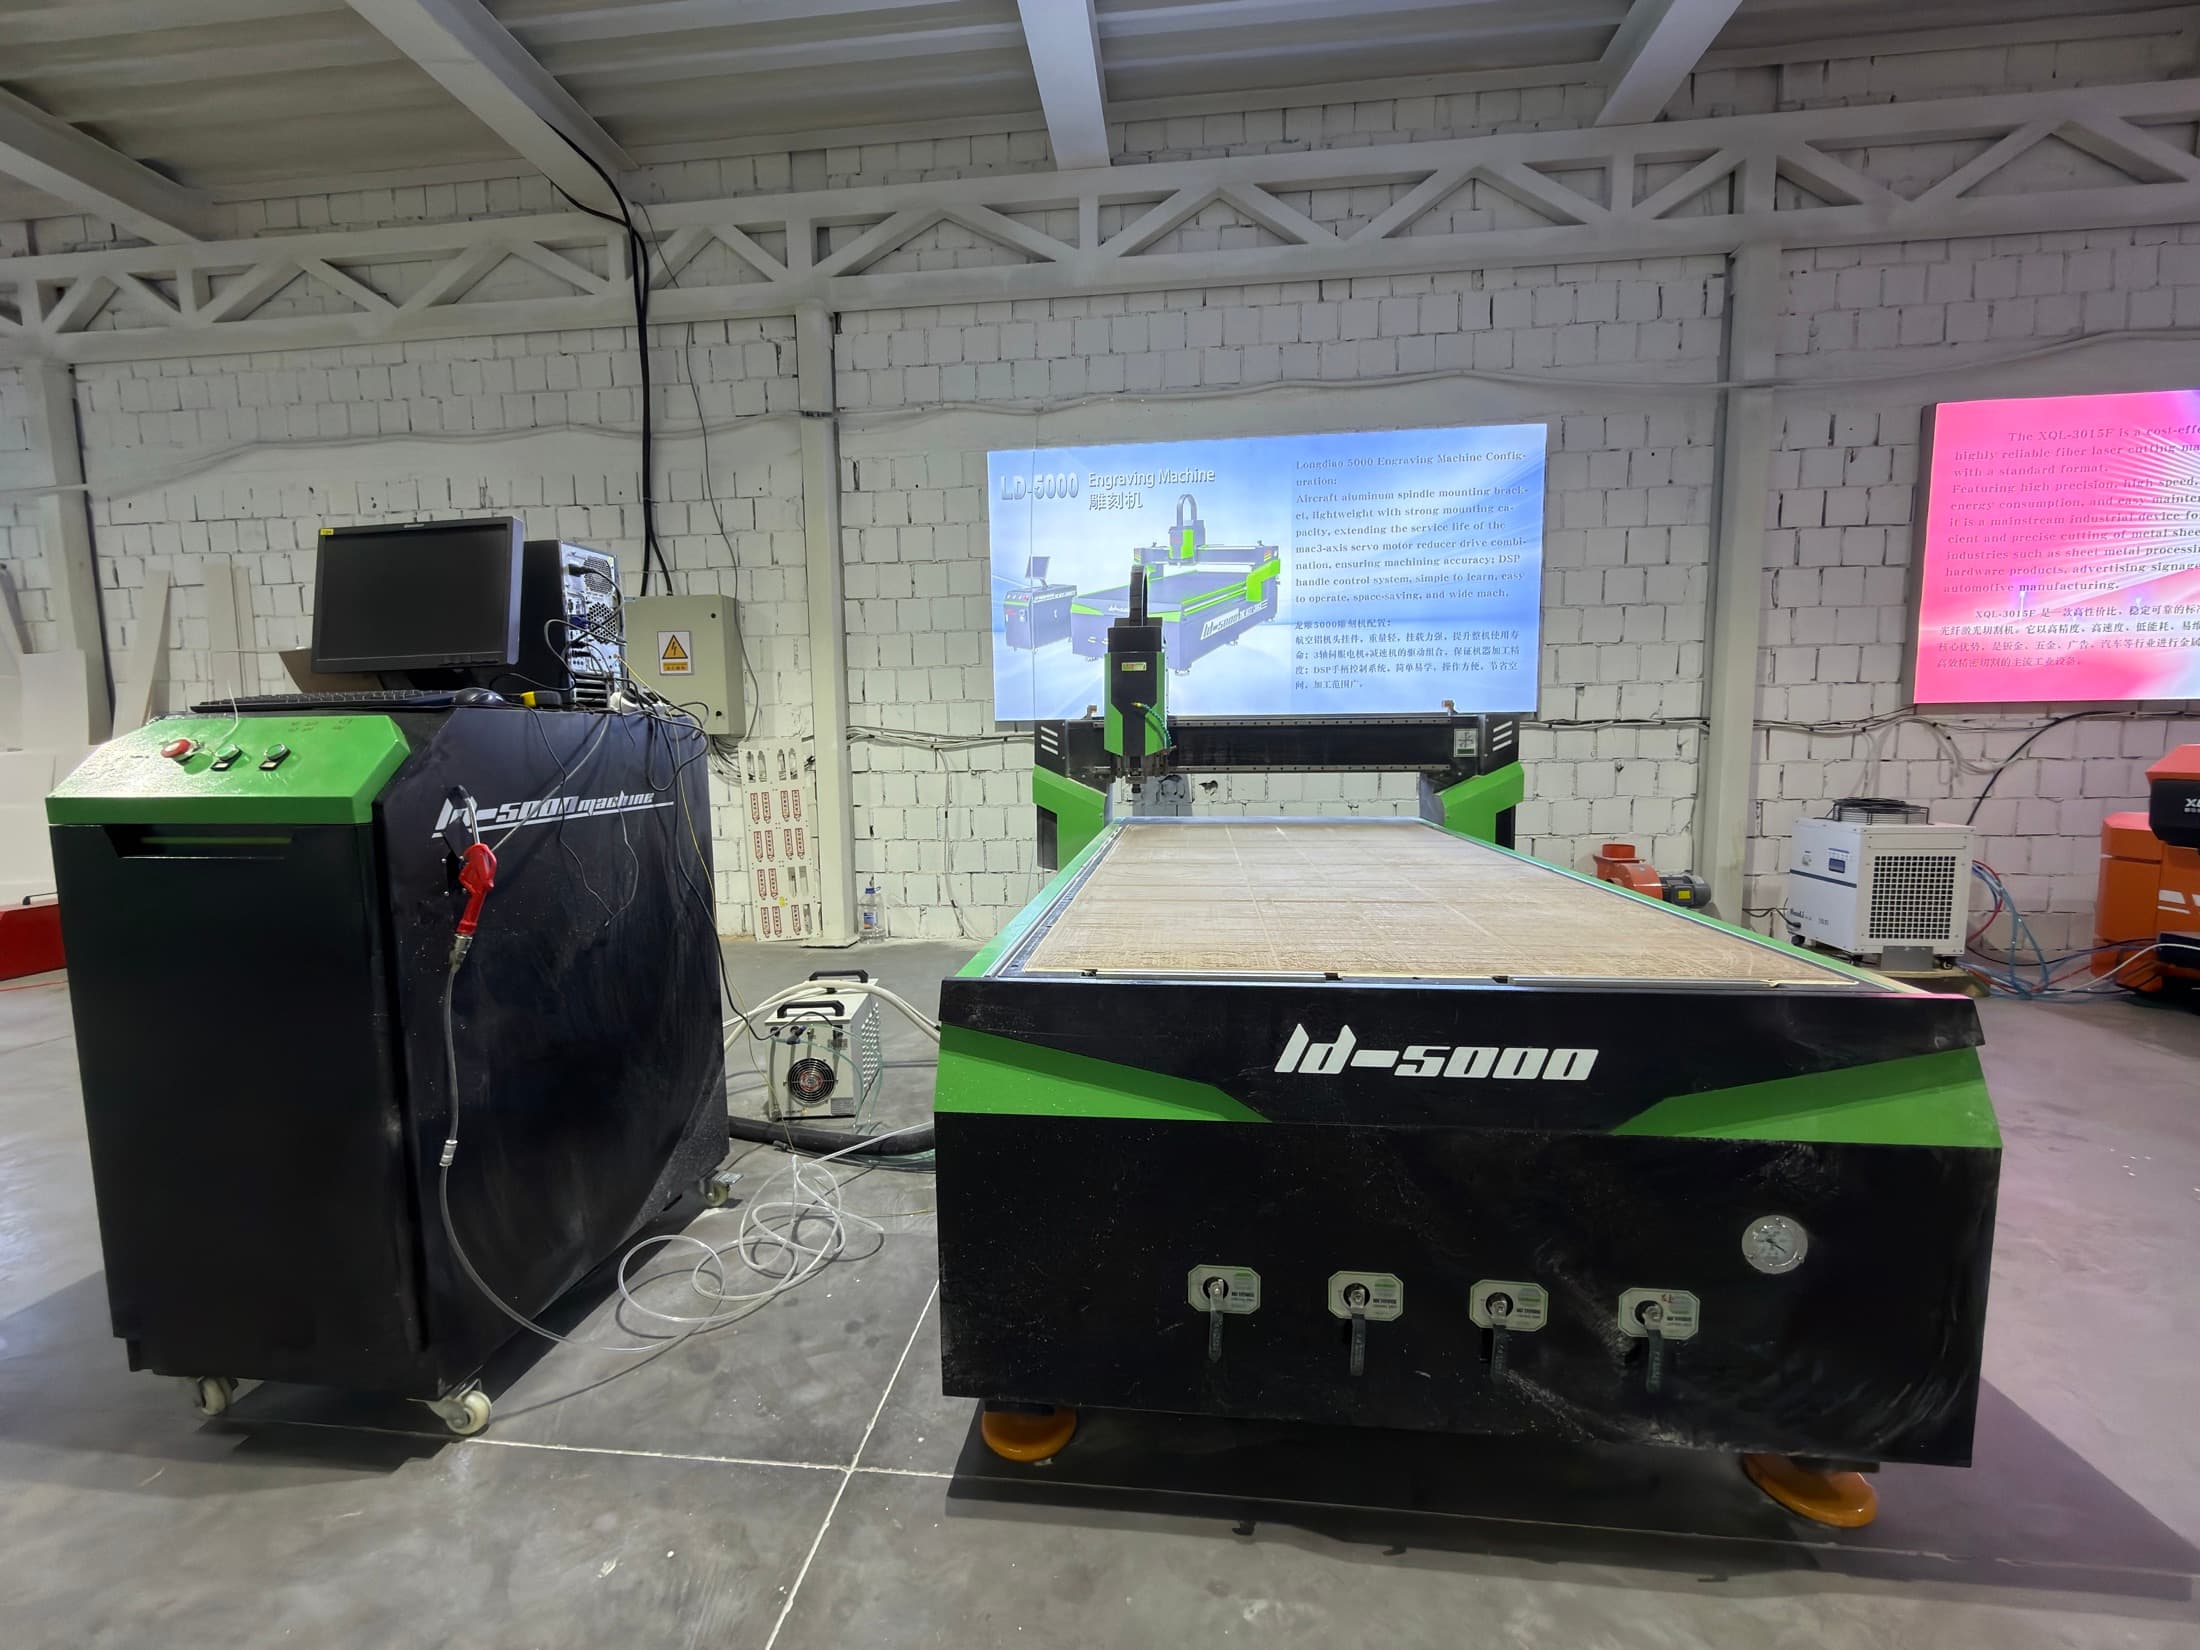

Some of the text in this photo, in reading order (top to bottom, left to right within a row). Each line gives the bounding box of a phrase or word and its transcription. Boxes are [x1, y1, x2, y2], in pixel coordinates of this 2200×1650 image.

[2008, 432, 2033, 441] The
[2038, 428, 2113, 441] XQL-3015F
[2119, 427, 2129, 437] is
[1347, 457, 1374, 467] 5000
[1377, 455, 1433, 467] Engraving
[1438, 453, 1482, 463] Machine
[1486, 451, 1526, 461] Config-
[1954, 450, 1995, 462] highly
[2002, 448, 2051, 459] reliable
[2056, 447, 2087, 457] fiber
[2092, 445, 2122, 455] laser
[1954, 467, 1982, 477] with
[2000, 465, 2055, 476] standard
[2061, 464, 2108, 473] format.
[1001, 468, 1216, 500] LD-5000 Engraving Machine
[1296, 477, 1337, 487] uration:
[1952, 483, 2016, 494] Featuring
[2020, 482, 2049, 493] high
[2123, 478, 2153, 488] high
[1088, 492, 1143, 510] 雕刻机
[1296, 485, 1528, 503] Aircraft aluminum spindle mounting brack-
[1950, 502, 1994, 511] energy
[2089, 497, 2113, 506] and
[2118, 498, 2145, 506] easy
[2152, 494, 2200, 504] mainte
[1312, 508, 1373, 519] lightweight
[1377, 507, 1401, 517] with
[1405, 506, 1439, 516] strong
[1443, 503, 1494, 513] mounting
[1498, 503, 1513, 512] ca-
[1949, 518, 1958, 527] it
[1963, 517, 1974, 527] is
[1978, 519, 1985, 527] a
[1990, 516, 2065, 526] mainstream
[2070, 512, 2133, 524] industrial
[2138, 512, 2180, 521] device
[1296, 519, 1504, 538] pacity, extending the service life of the
[1351, 543, 1379, 551] servo
[1382, 541, 1414, 550] motor
[1416, 539, 1456, 549] reducer
[1459, 538, 1488, 548] drive
[1491, 536, 1528, 546] combi-
[1948, 534, 1979, 544] cient
[1984, 533, 2007, 542] and
[2011, 533, 2056, 543] precise
[2060, 531, 2108, 541] cutting
[2113, 530, 2126, 539] of
[2131, 529, 2167, 538] metal
[1946, 550, 2008, 560] industries
[2013, 548, 2042, 558] such
[2047, 550, 2061, 558] as
[2065, 547, 2098, 557] sheet
[2104, 545, 2140, 556] metal
[1335, 559, 1382, 569] ensuring
[1384, 556, 1440, 567] machining
[1499, 554, 1521, 563] DSP
[1945, 567, 2005, 577] hardware
[2072, 563, 2146, 574] advertising
[1296, 577, 1330, 587] handle
[1333, 575, 1370, 585] control
[1415, 573, 1449, 583] simple
[1453, 573, 1464, 581] to
[1501, 571, 1525, 581] easy
[1944, 581, 2119, 593] automotive manufacturing.
[1295, 595, 1306, 603] to
[1426, 590, 1445, 599] and
[1449, 588, 1473, 598] wide
[1975, 609, 2037, 618] XQL-3015F
[576, 790, 655, 815] machine
[1274, 1023, 1599, 1081] ld-5000
